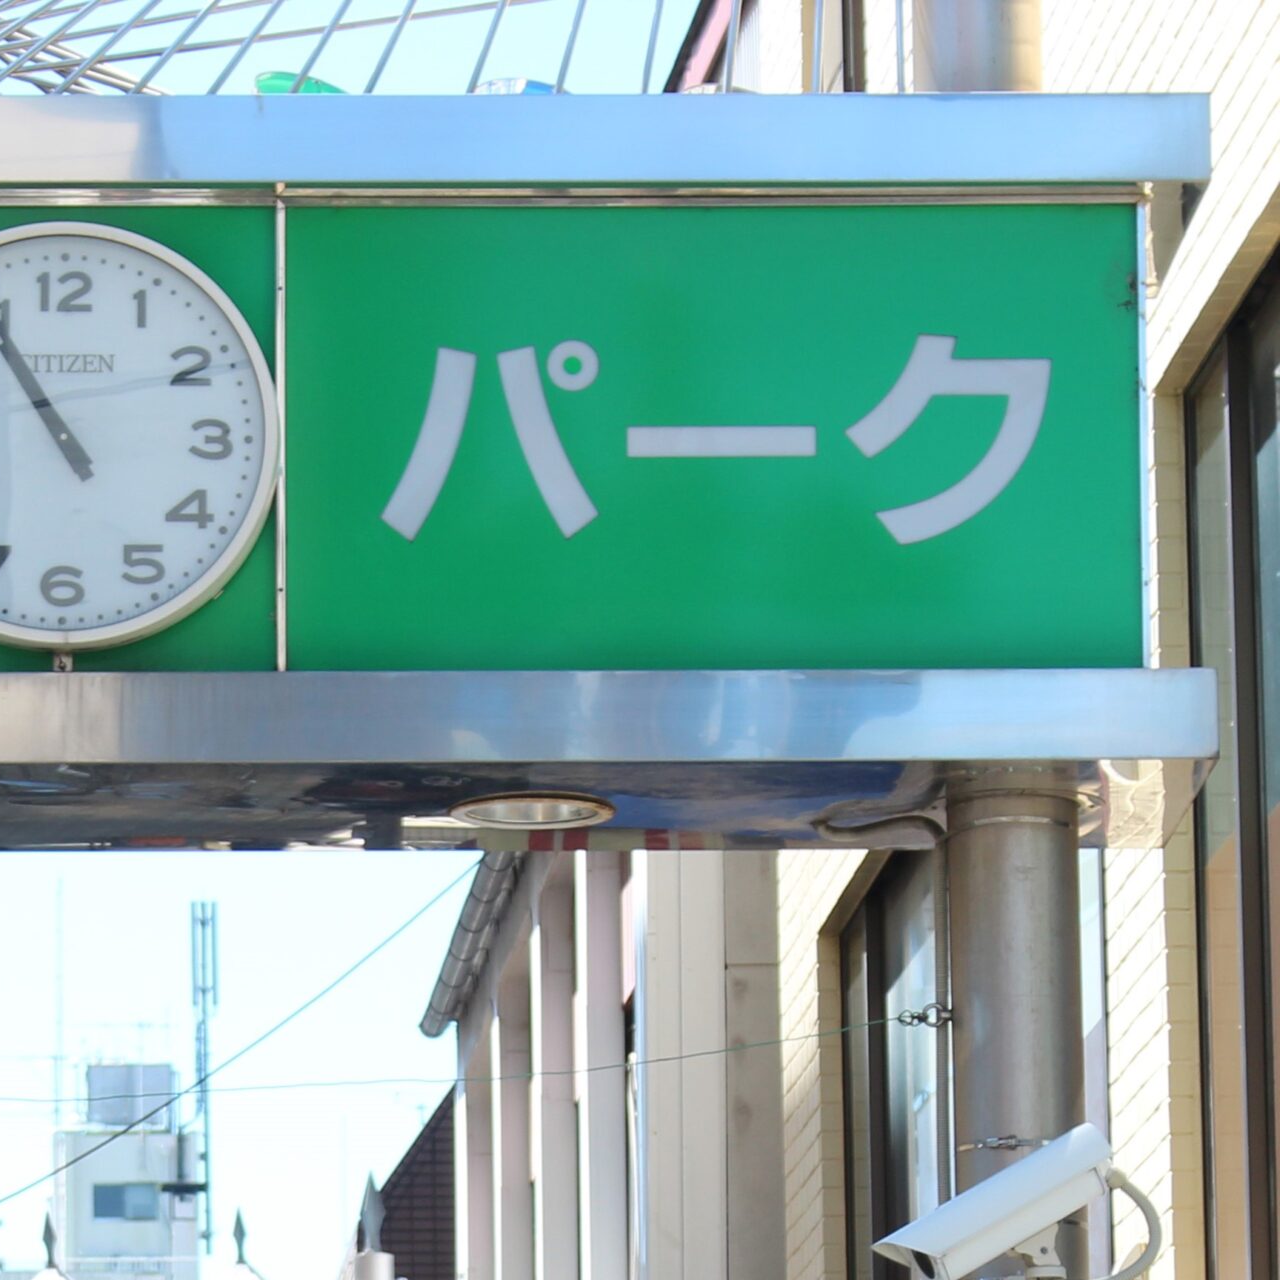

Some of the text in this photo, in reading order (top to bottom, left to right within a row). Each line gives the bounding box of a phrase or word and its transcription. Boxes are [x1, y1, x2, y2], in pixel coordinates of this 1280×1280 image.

[37, 271, 92, 312] 12
[133, 290, 147, 328] 1
[170, 346, 212, 386] 2
[189, 419, 233, 460] 3
[381, 335, 1052, 545] パーク
[165, 489, 214, 529] 4
[122, 545, 165, 585] 5
[40, 566, 85, 607] 6
